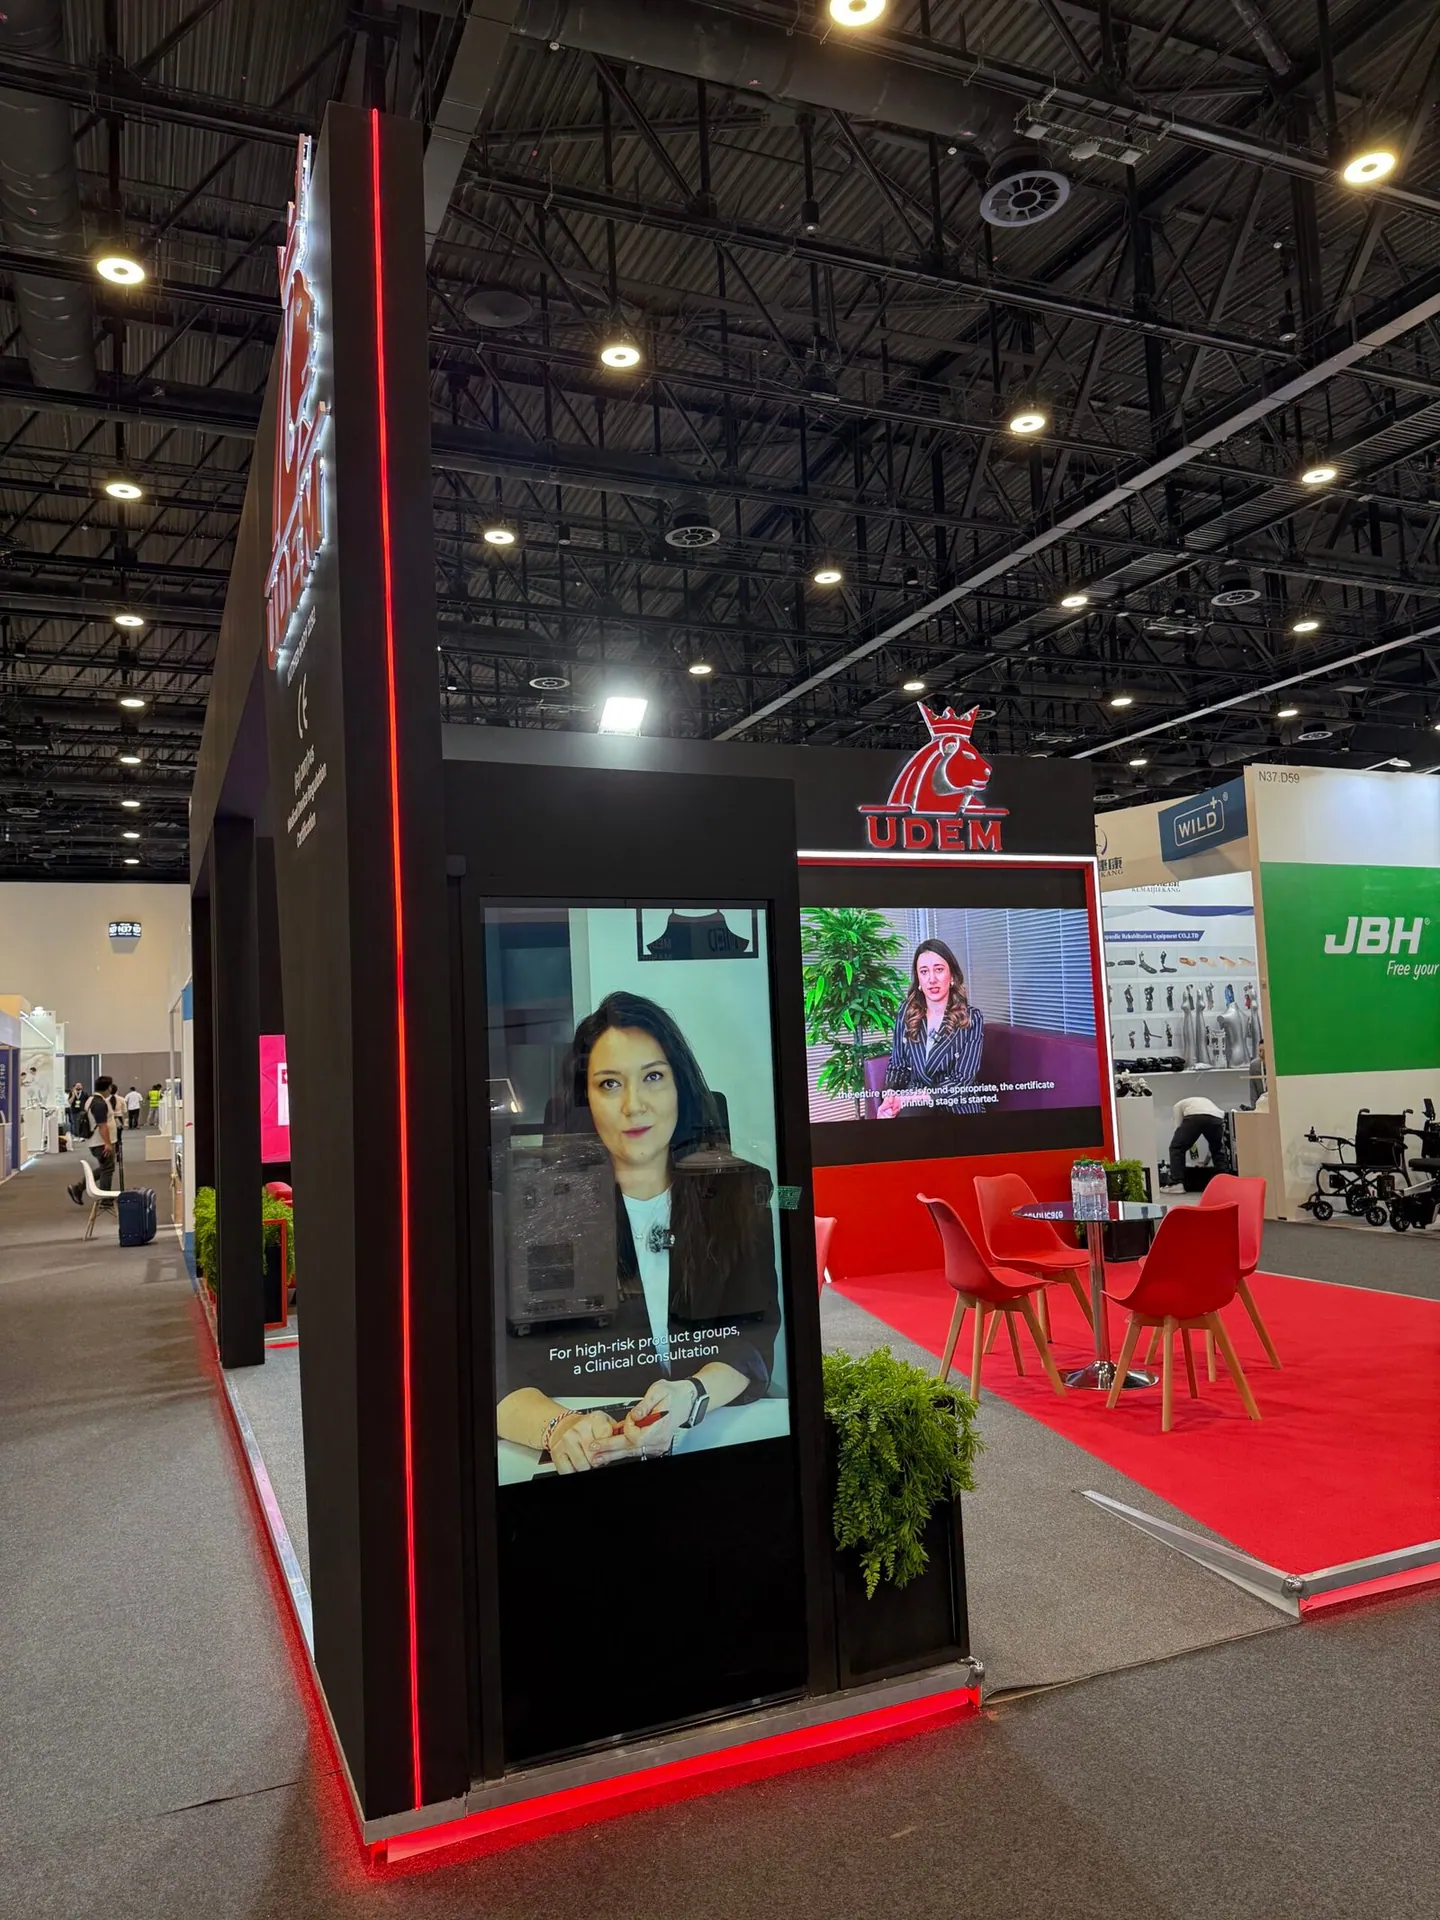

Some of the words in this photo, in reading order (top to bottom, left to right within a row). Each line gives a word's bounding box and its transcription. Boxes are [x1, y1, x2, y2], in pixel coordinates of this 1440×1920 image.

[1258, 771, 1300, 784] N37.D59
[866, 815, 1003, 851] UDEM
[1178, 811, 1217, 838] WILD
[1324, 916, 1424, 954] JBH
[1386, 960, 1412, 976] Free
[1413, 963, 1440, 980] your
[854, 1088, 880, 1099] entire
[881, 1088, 914, 1099] process
[923, 1086, 948, 1095] found
[949, 1083, 999, 1095] appropriate,
[1000, 1082, 1014, 1091] the
[1015, 1080, 1055, 1090] certificate
[901, 1097, 934, 1108] printing
[935, 1096, 959, 1107] stage
[960, 1095, 967, 1104] is
[968, 1094, 999, 1104] started.
[549, 1347, 572, 1361] For
[575, 1337, 636, 1358] high-risk
[638, 1330, 690, 1351] product
[692, 1324, 740, 1343] groups,
[573, 1365, 582, 1375] a
[585, 1353, 634, 1373] Clinical
[637, 1344, 719, 1365] Consultation
